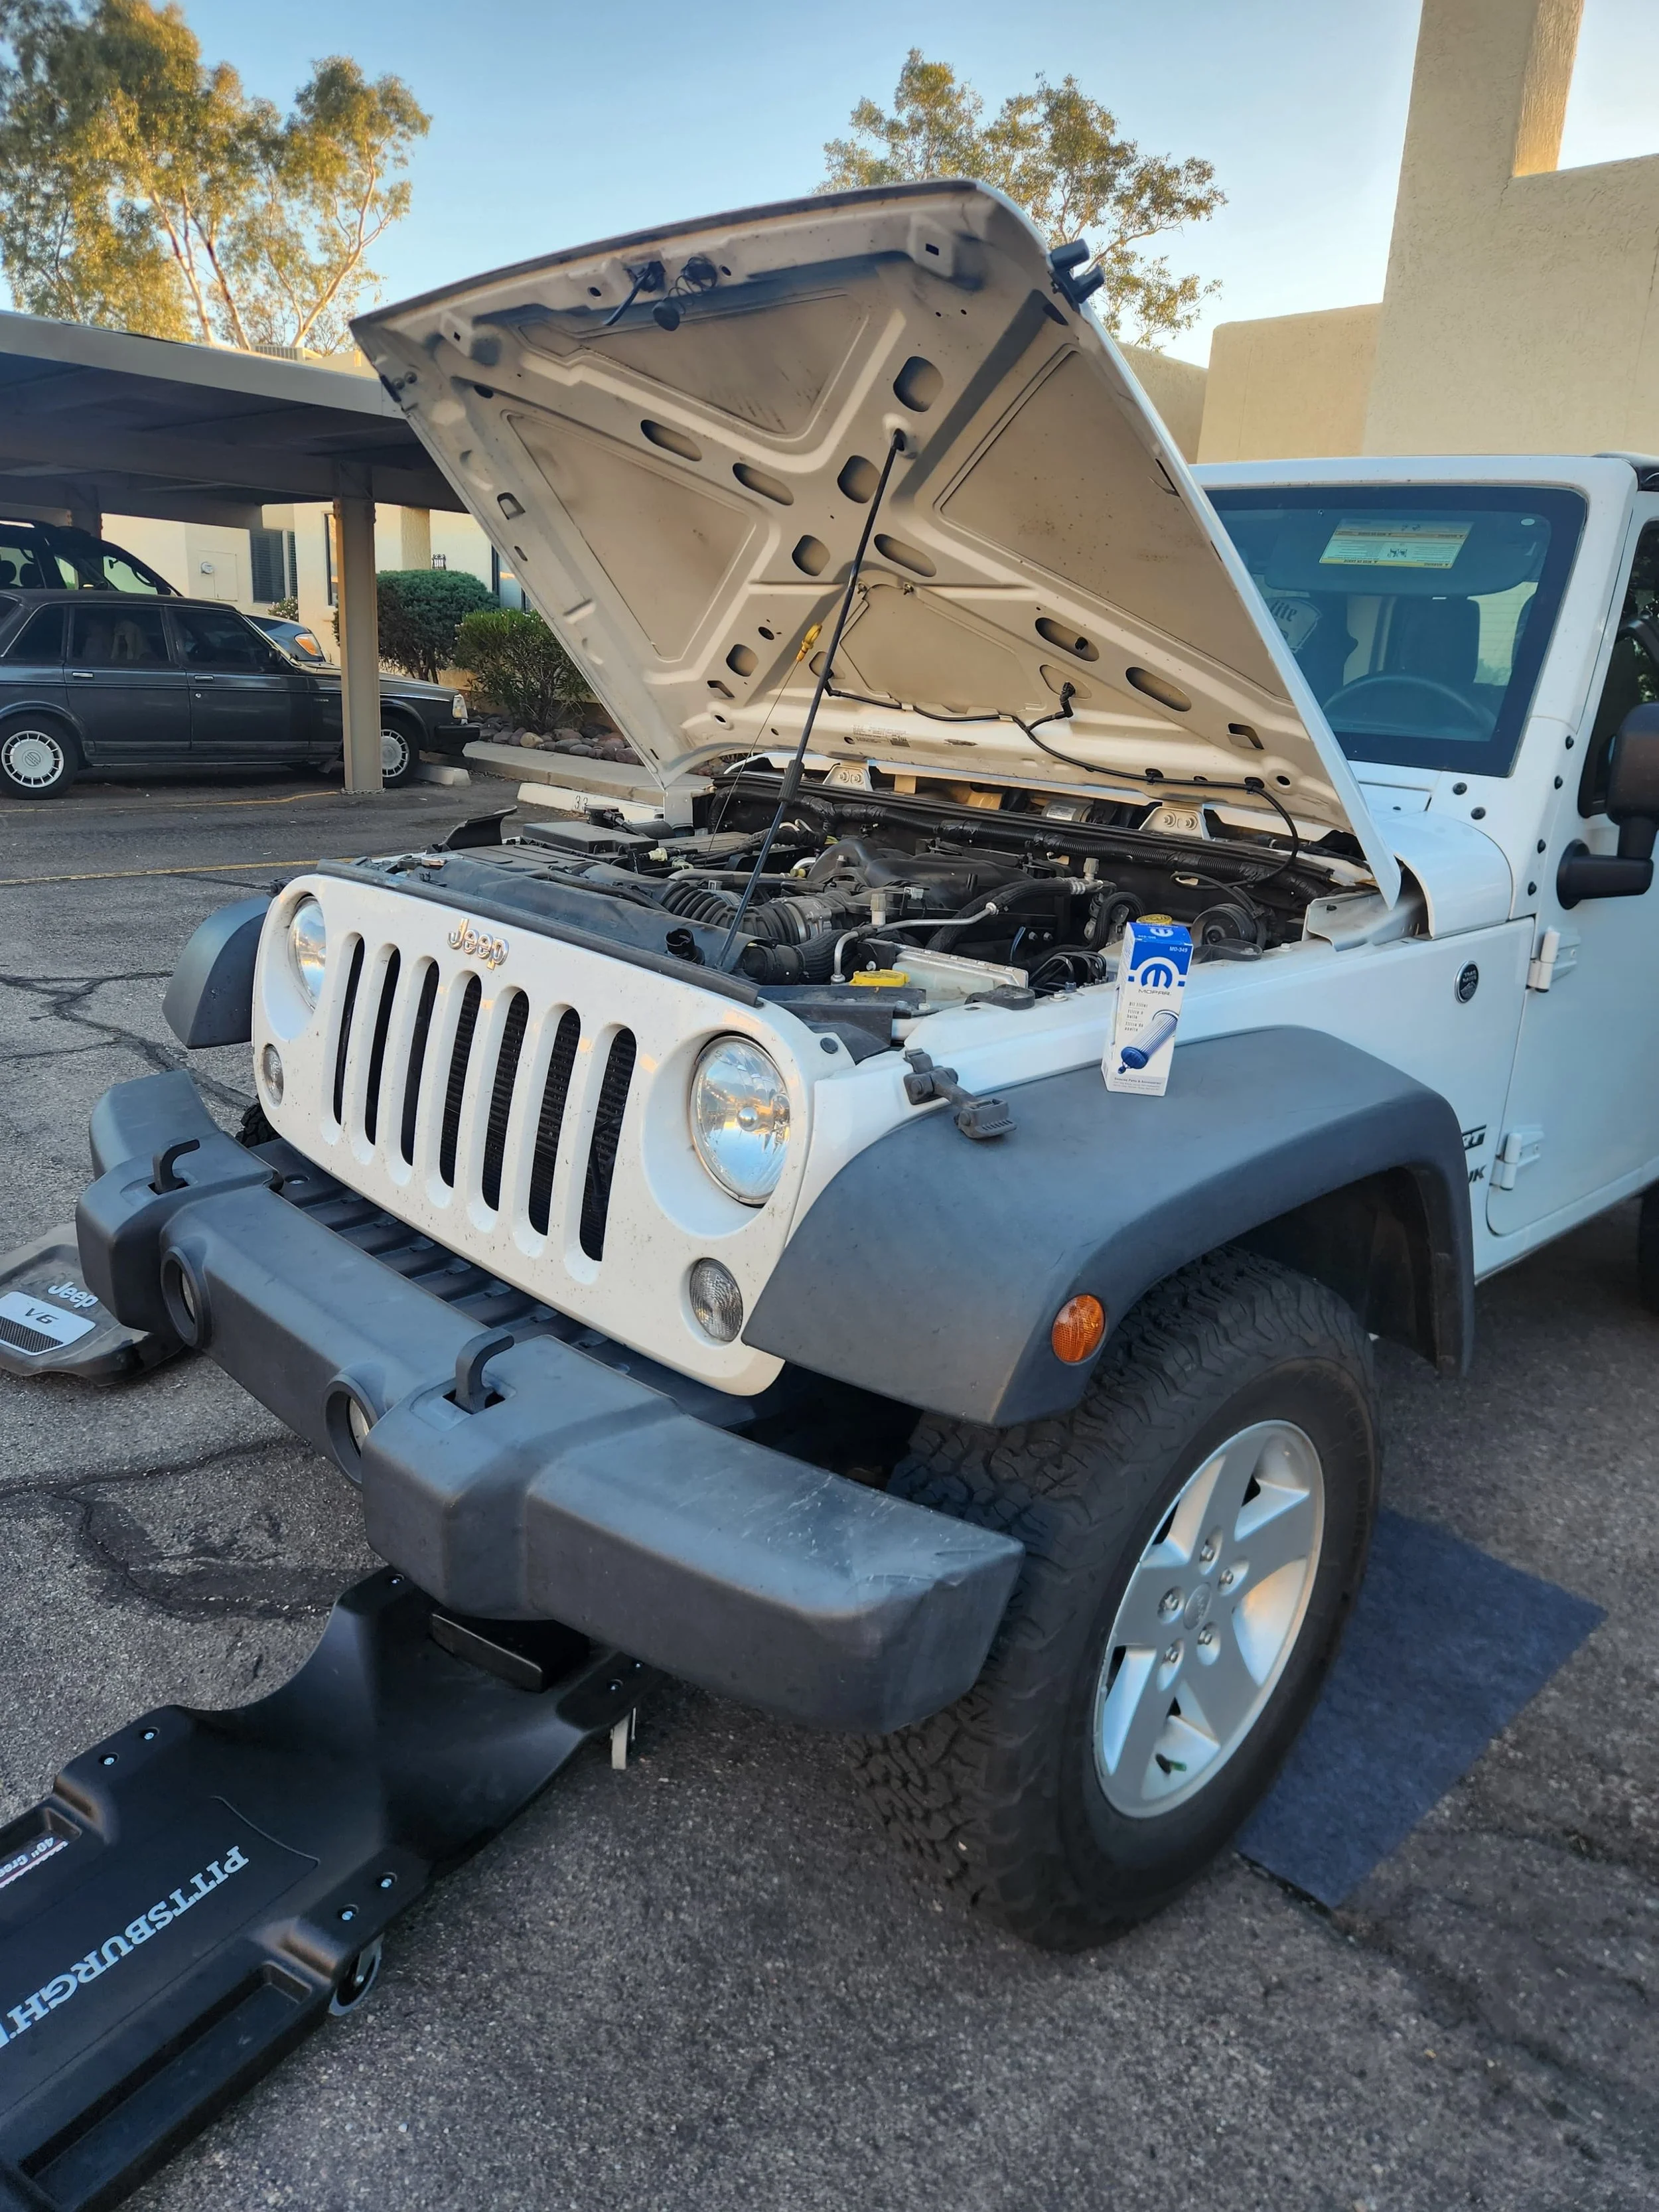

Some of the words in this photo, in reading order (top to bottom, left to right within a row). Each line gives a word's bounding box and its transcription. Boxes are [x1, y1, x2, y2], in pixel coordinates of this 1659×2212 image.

[447, 918, 509, 970] Jeep
[48, 1282, 99, 1309] Jeep
[25, 1307, 59, 1325] V6
[7, 1845, 250, 2035] PITTSBURGH
